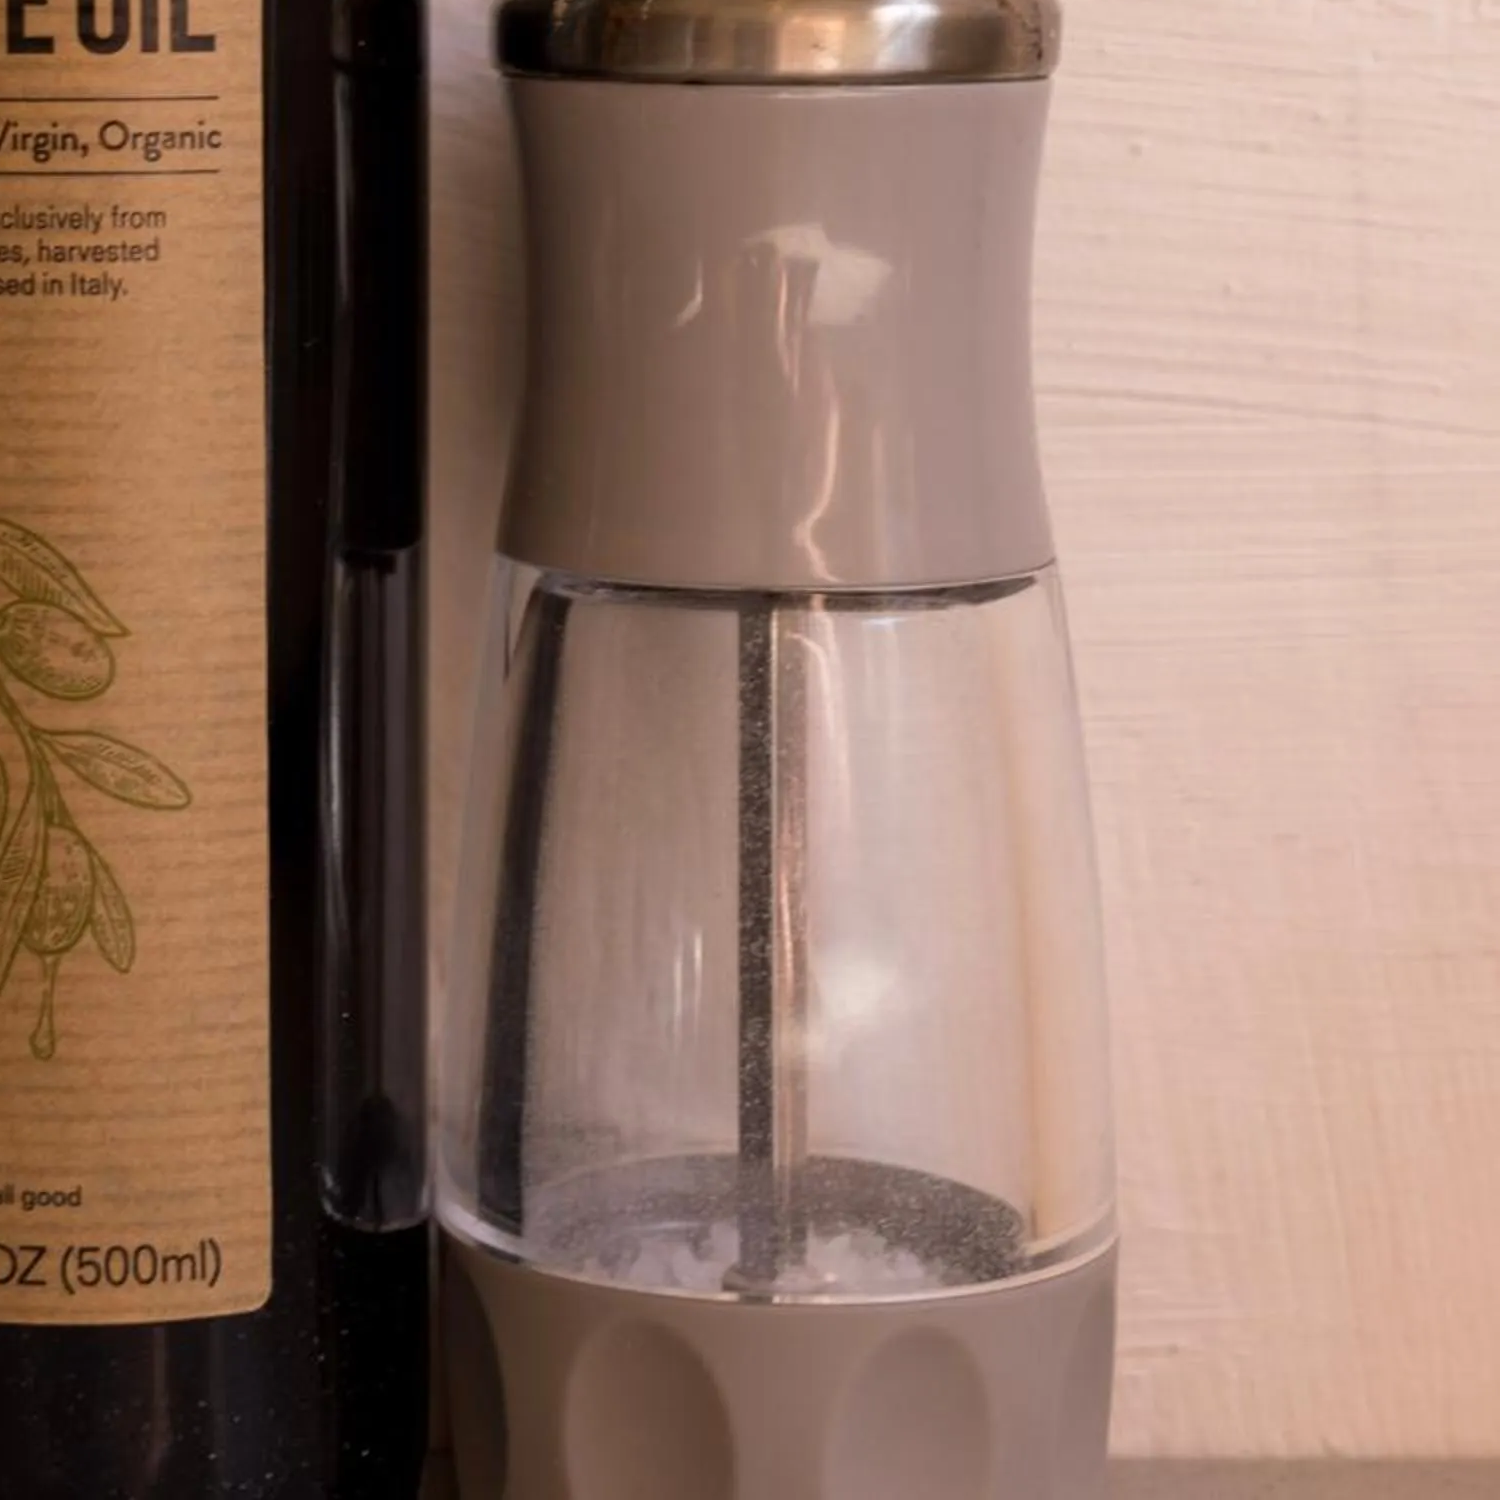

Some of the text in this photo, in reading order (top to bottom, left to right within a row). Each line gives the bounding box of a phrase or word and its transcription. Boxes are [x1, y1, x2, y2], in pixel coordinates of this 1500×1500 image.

[99, 119, 223, 163] Organic
[110, 204, 167, 229] from
[37, 237, 160, 263] harvested
[42, 272, 64, 295] in
[70, 271, 129, 301] Italy.
[21, 1185, 83, 1211] good
[60, 1237, 223, 1295] (500ml)
